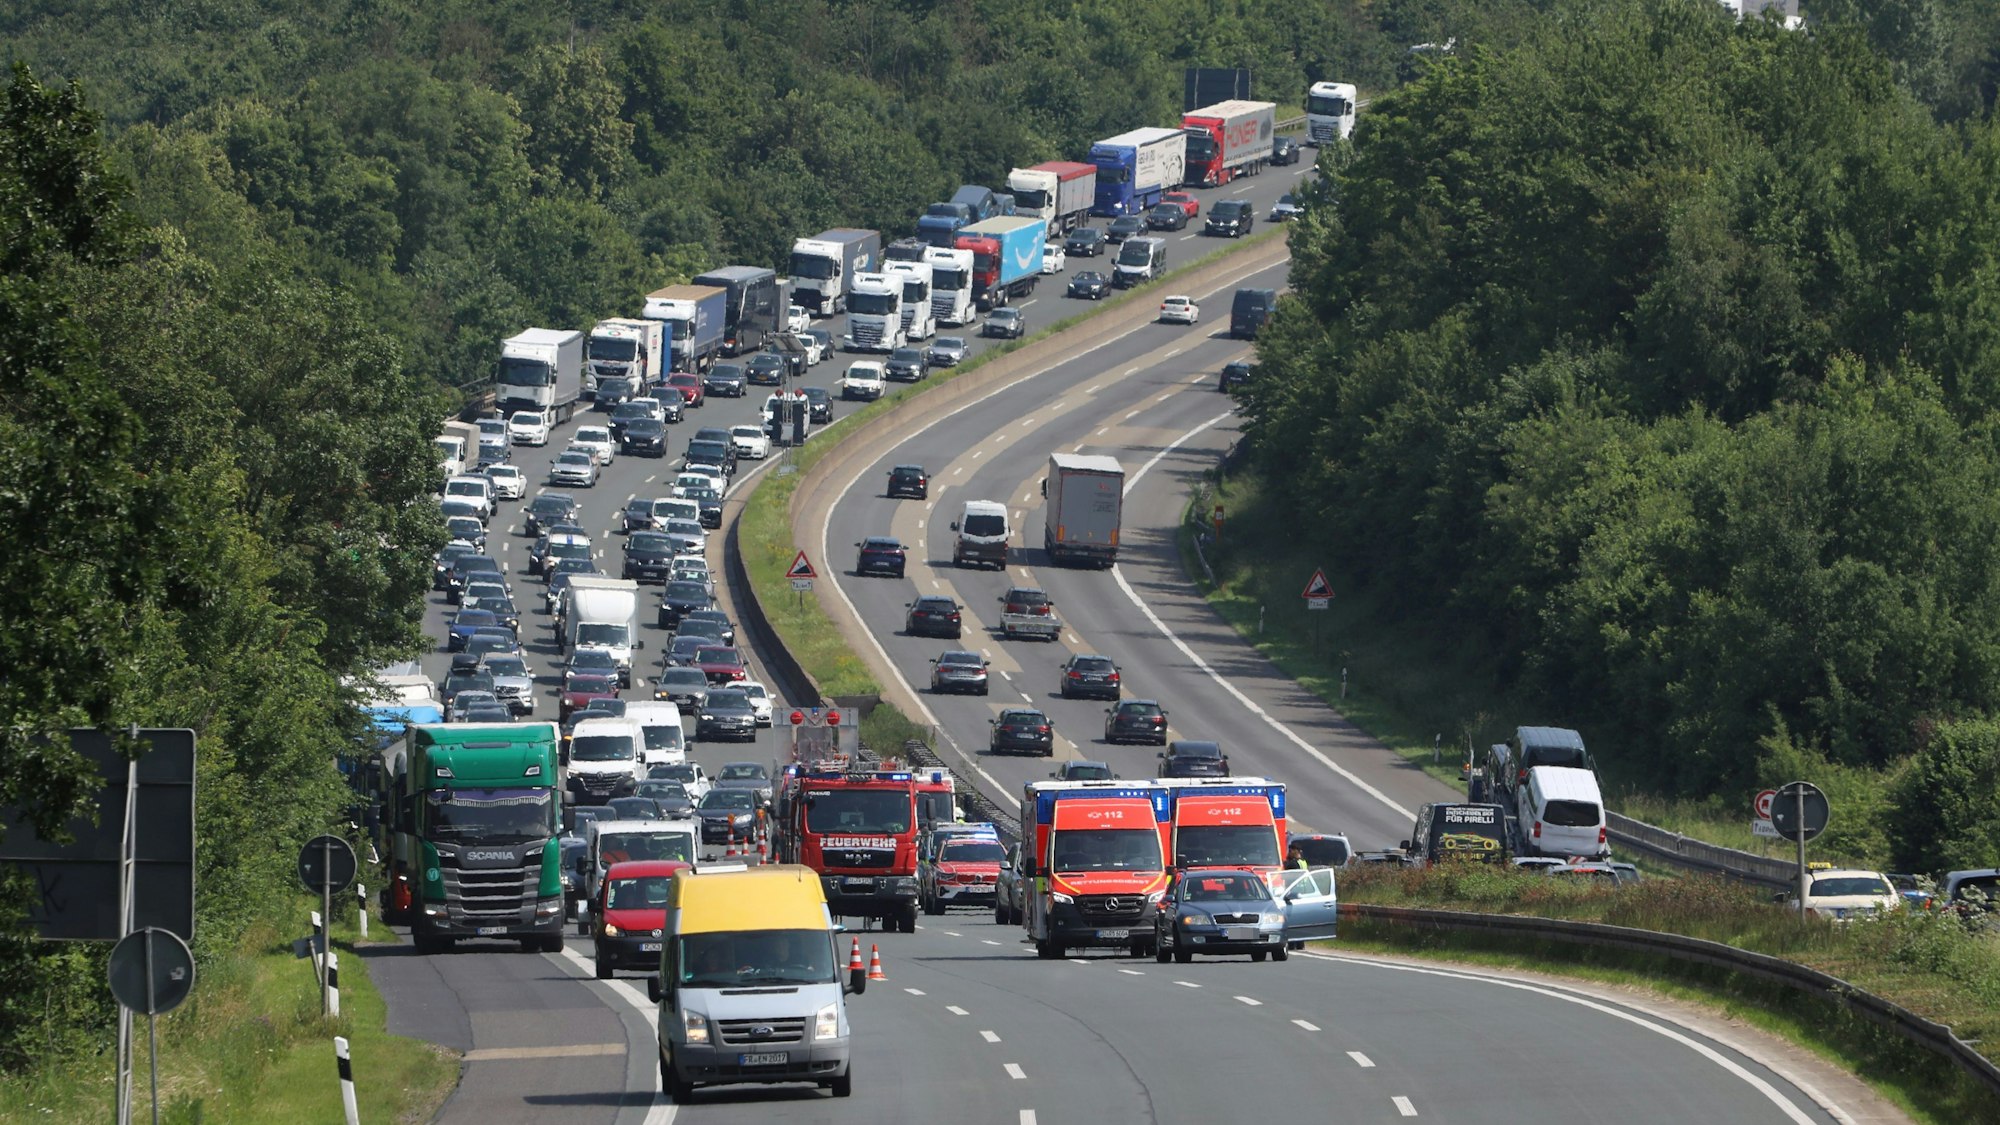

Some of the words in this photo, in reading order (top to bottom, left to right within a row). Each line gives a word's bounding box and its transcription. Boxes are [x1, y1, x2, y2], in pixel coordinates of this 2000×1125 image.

[1104, 811, 1124, 819] 112
[1223, 807, 1242, 816] 112
[1446, 815, 1463, 823] FÜR
[820, 837, 897, 848] FEUERWEHR
[467, 851, 515, 861] SCANIA
